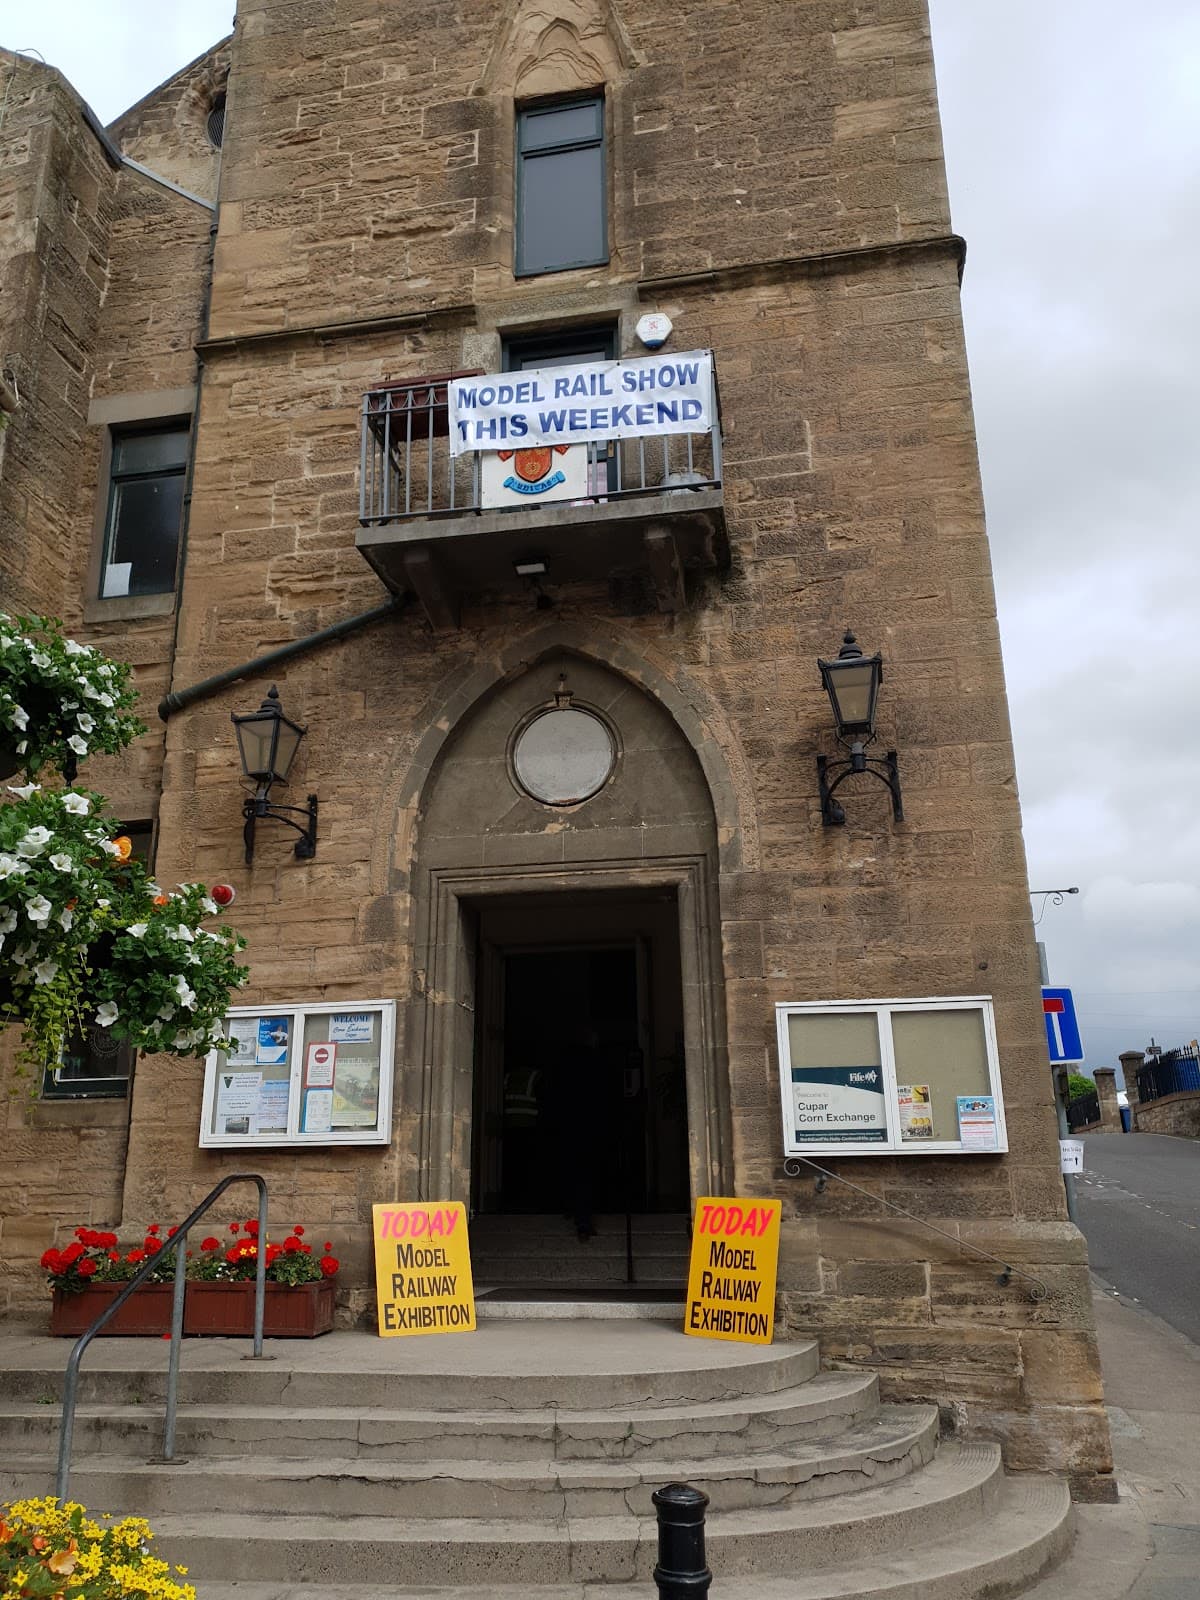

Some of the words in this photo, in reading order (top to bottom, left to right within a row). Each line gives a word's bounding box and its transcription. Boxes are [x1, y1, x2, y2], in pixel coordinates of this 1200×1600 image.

[457, 381, 545, 409] MODEL
[554, 373, 613, 399] RAIL
[621, 362, 699, 393] SHOW
[457, 413, 528, 441] THIS
[539, 399, 702, 434] WEEKEND
[334, 1015, 369, 1023] WELCOME
[849, 1072, 865, 1082] Fife
[798, 1102, 829, 1112] Cupar
[799, 1113, 824, 1122] Corn
[826, 1112, 876, 1123] Exchange
[380, 1209, 459, 1239] TODAY
[700, 1205, 774, 1237] TODAY
[396, 1243, 450, 1270] MODEL
[709, 1241, 757, 1271] MODEL
[391, 1273, 457, 1299] RAILWAY
[701, 1271, 761, 1303] RAILWAY
[384, 1303, 471, 1330] EXHIBITION
[690, 1301, 768, 1337] EXHIBITION
